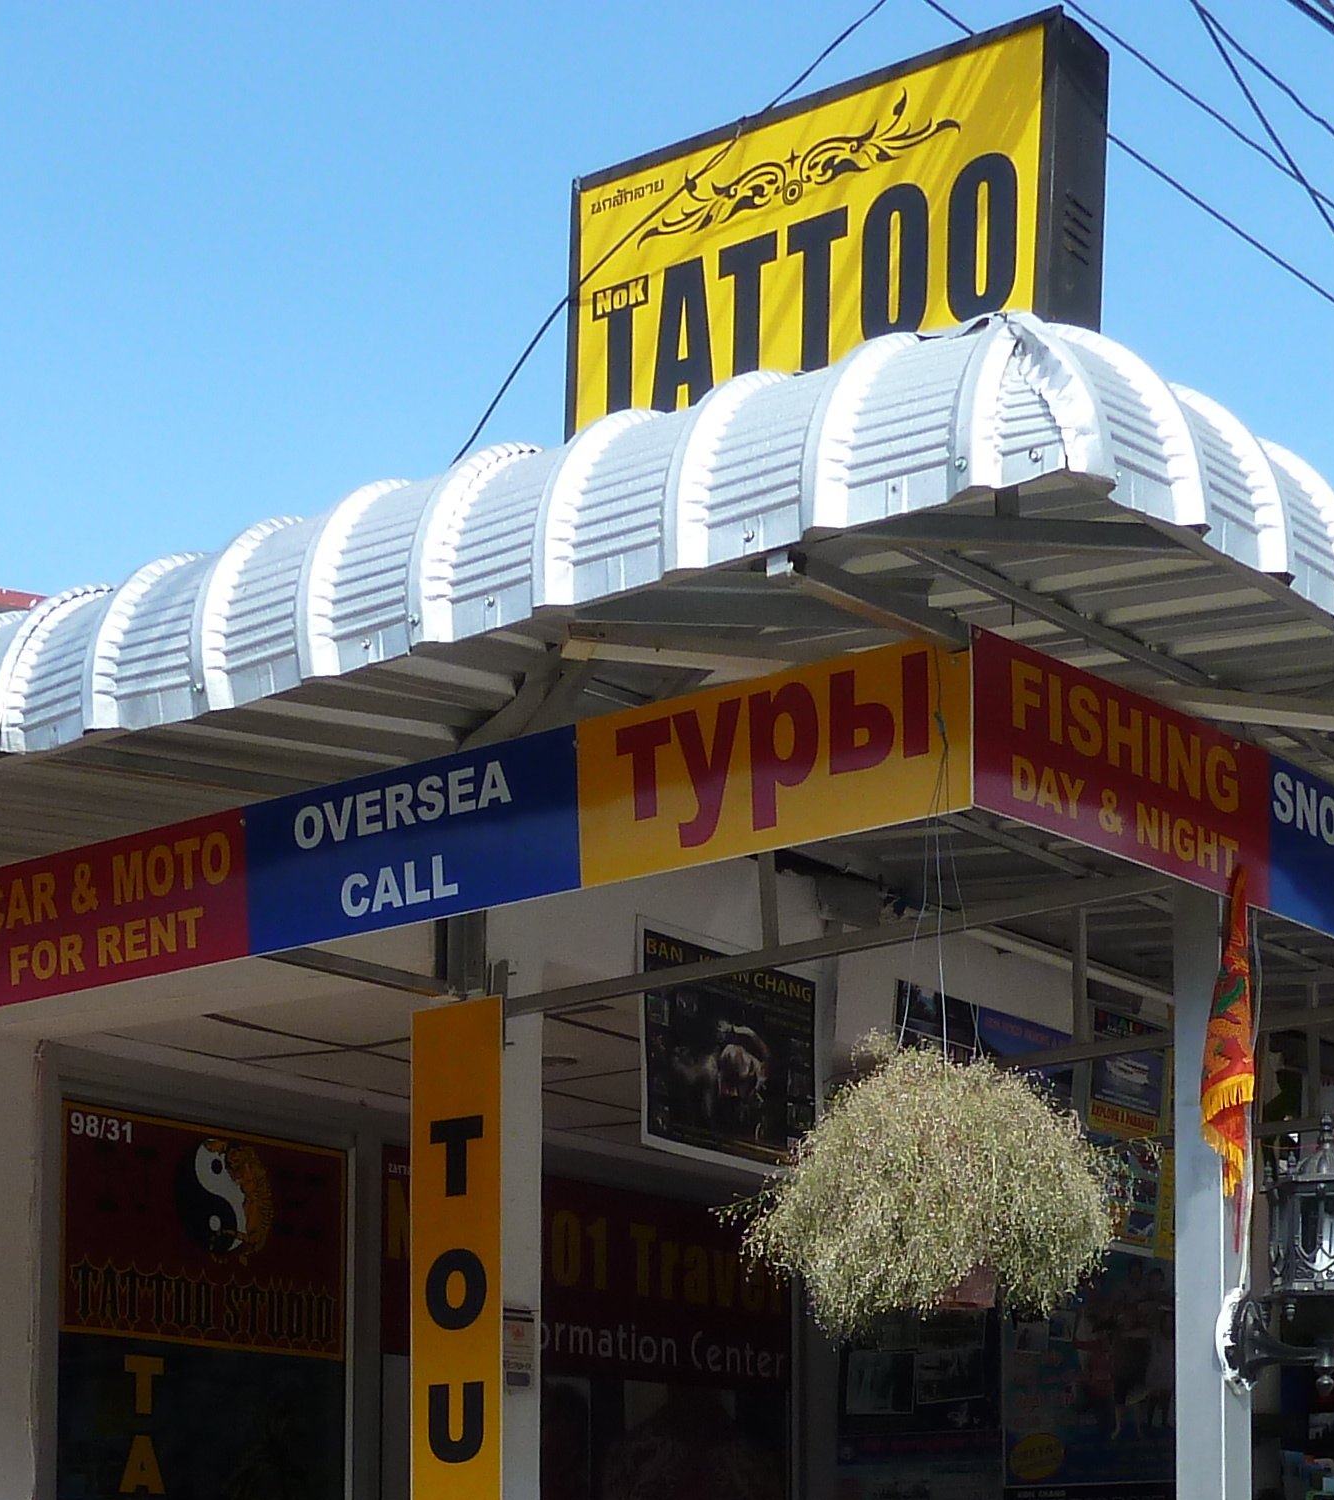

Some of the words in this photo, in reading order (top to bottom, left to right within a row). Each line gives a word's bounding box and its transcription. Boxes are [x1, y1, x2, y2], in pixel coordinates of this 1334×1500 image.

[590, 178, 664, 215] นกสักลาย
[607, 152, 1019, 417] TATTOO
[1010, 658, 1240, 814] FISHING
[294, 760, 512, 850] OVERSEA
[1011, 755, 1085, 825] DAY
[1098, 787, 1125, 836] &
[1136, 797, 1241, 878] NIGHT
[71, 867, 97, 914] &
[112, 832, 232, 903] MOTO
[340, 855, 460, 919] CALL
[8, 934, 85, 986] FOR
[96, 906, 204, 963] RENT
[646, 936, 684, 963] BAN
[753, 972, 811, 1002] CHANG
[70, 1112, 133, 1144] 98/31
[69, 1253, 218, 1340] TATTOO
[223, 1273, 338, 1351] STUDIO
[691, 1330, 785, 1379] Center
